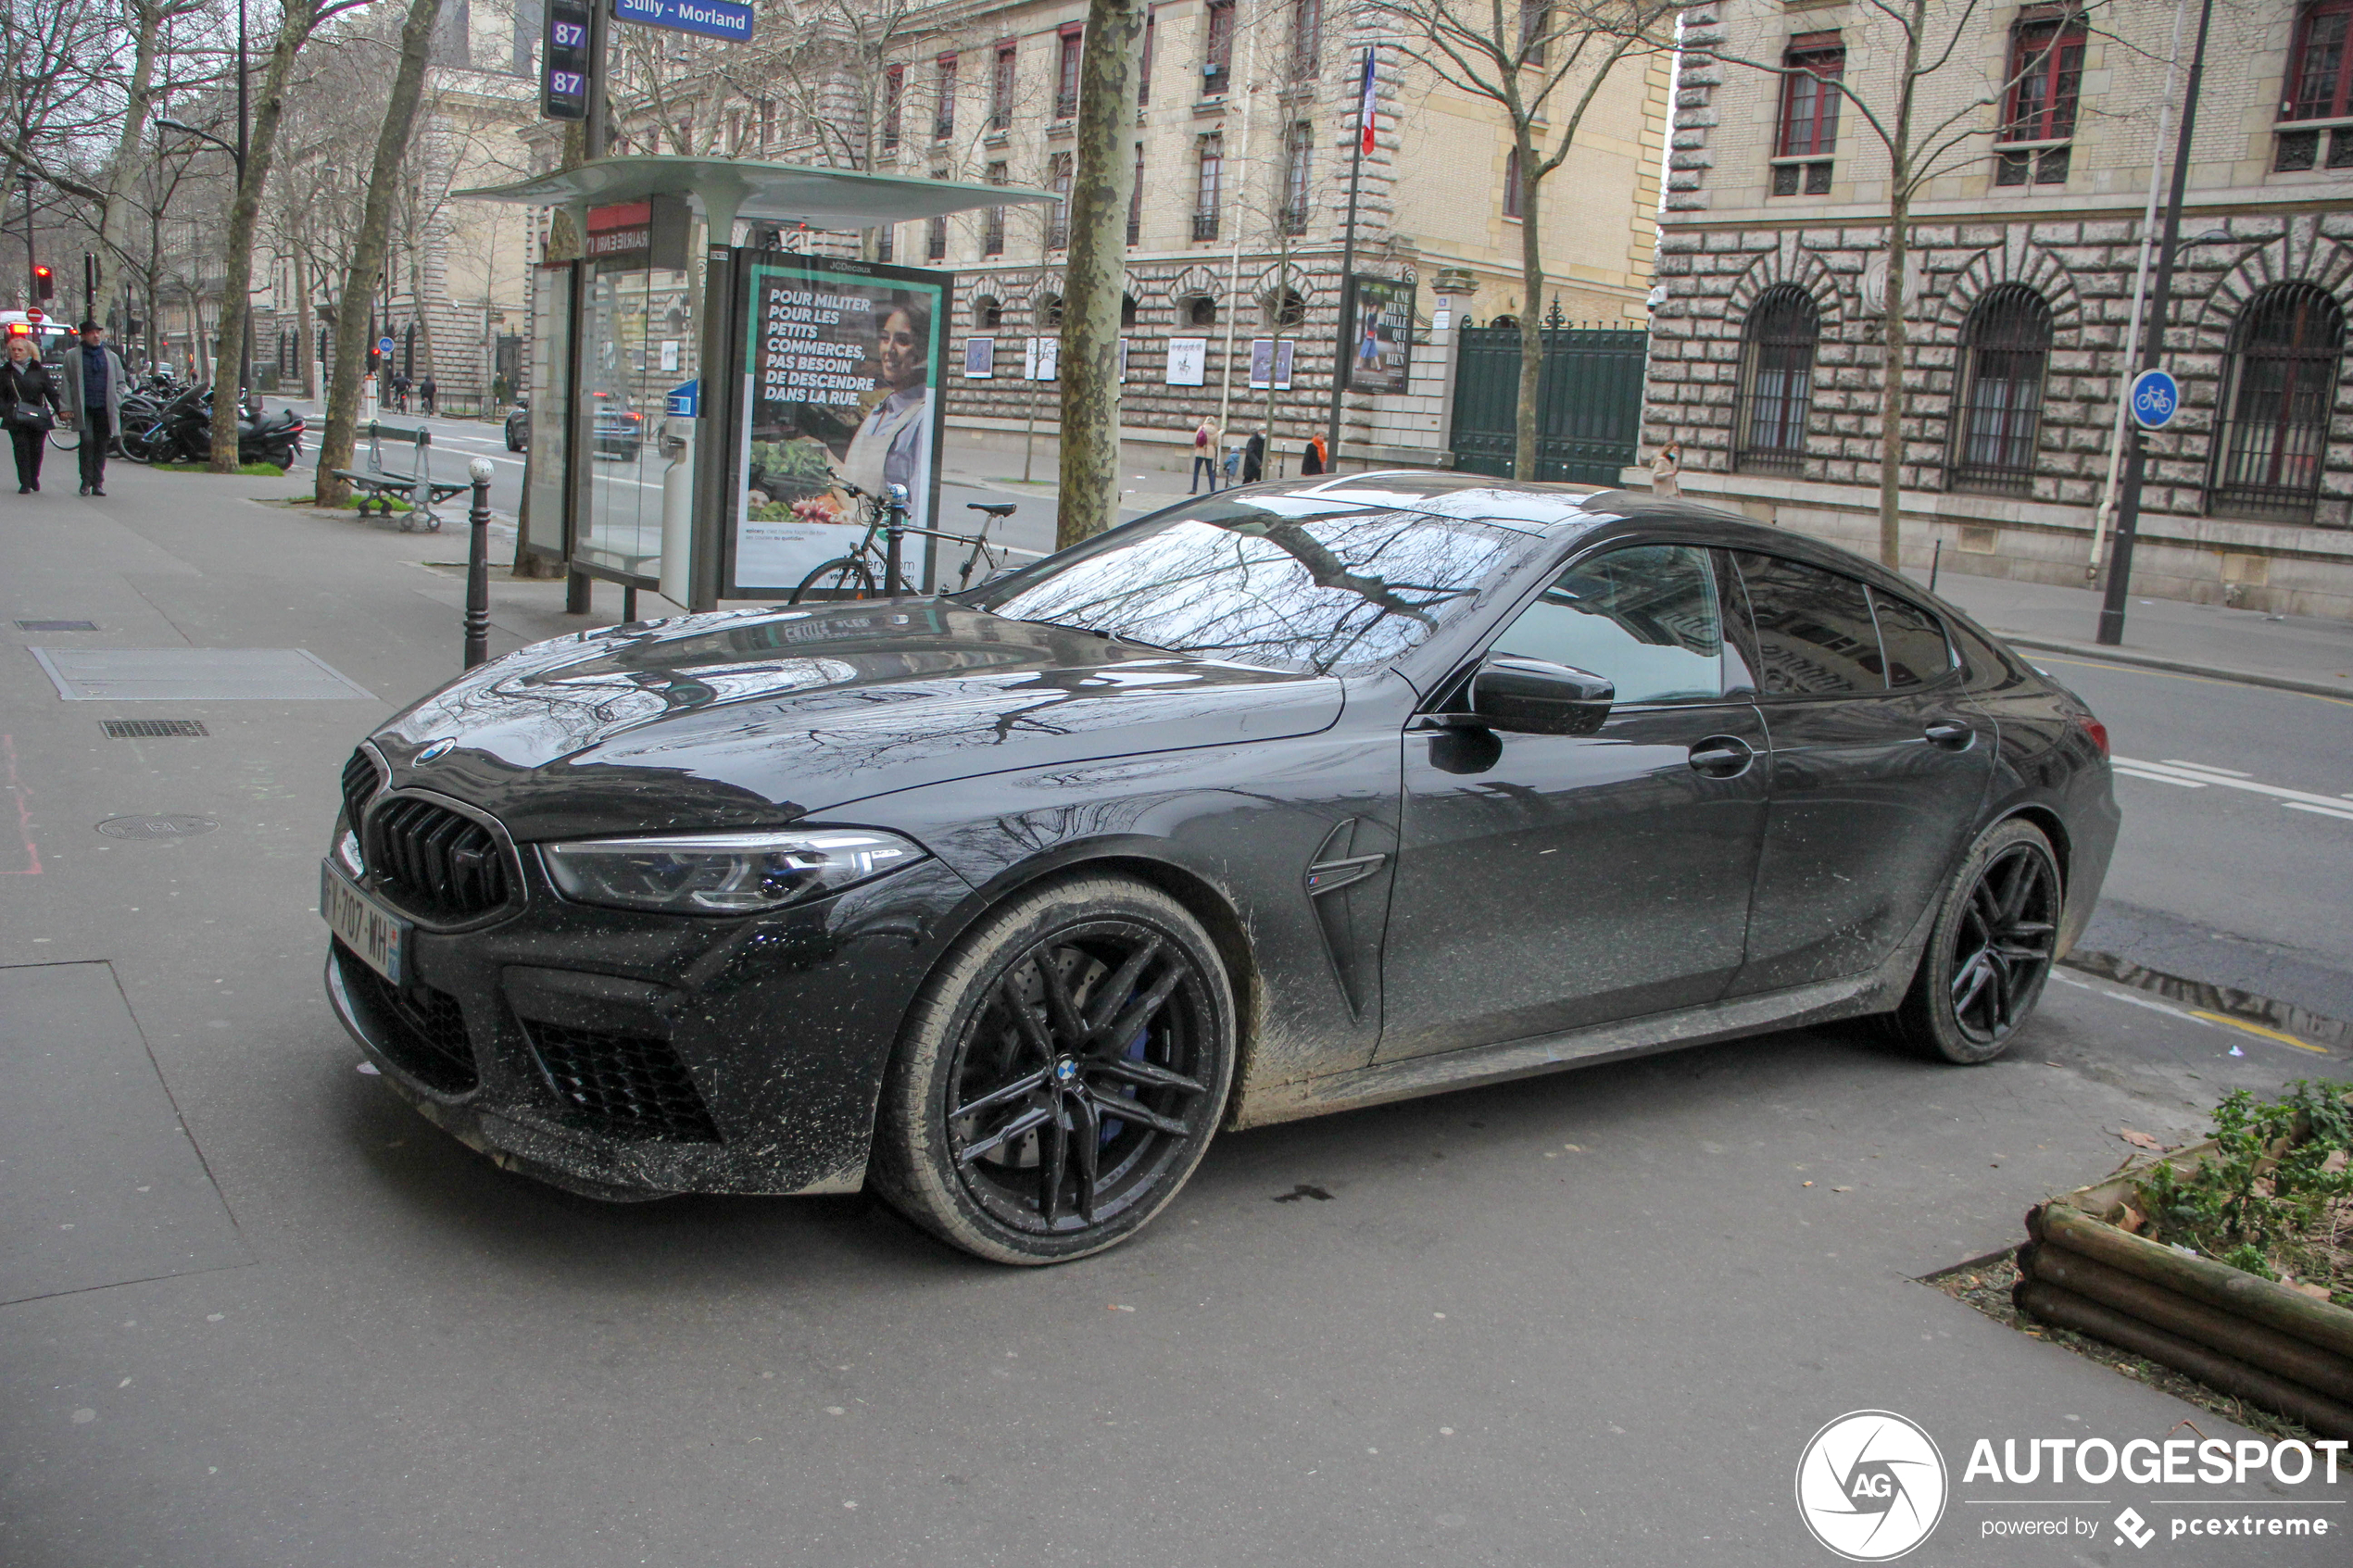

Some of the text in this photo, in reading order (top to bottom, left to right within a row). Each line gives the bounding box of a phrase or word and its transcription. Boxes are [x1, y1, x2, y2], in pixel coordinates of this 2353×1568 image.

[623, 0, 664, 18] Sully
[678, 3, 746, 31] Morland
[556, 24, 582, 45] 87
[553, 72, 580, 94] 87
[829, 261, 872, 274] JCDecaux
[769, 288, 871, 312] POUR MILITER
[1394, 290, 1410, 304] UNE
[768, 305, 840, 325] POUR LES
[1385, 302, 1408, 316] JEUNE
[767, 321, 818, 339] PETITS
[1385, 315, 1407, 329] FILLE
[1392, 329, 1407, 342] QUI
[767, 338, 866, 361] COMMERCES,
[1386, 353, 1404, 366] BIEN
[765, 354, 852, 374] PAS BESOIN
[765, 370, 875, 392] DE DESCENDRE
[764, 386, 861, 407] DANS LA RUE.
